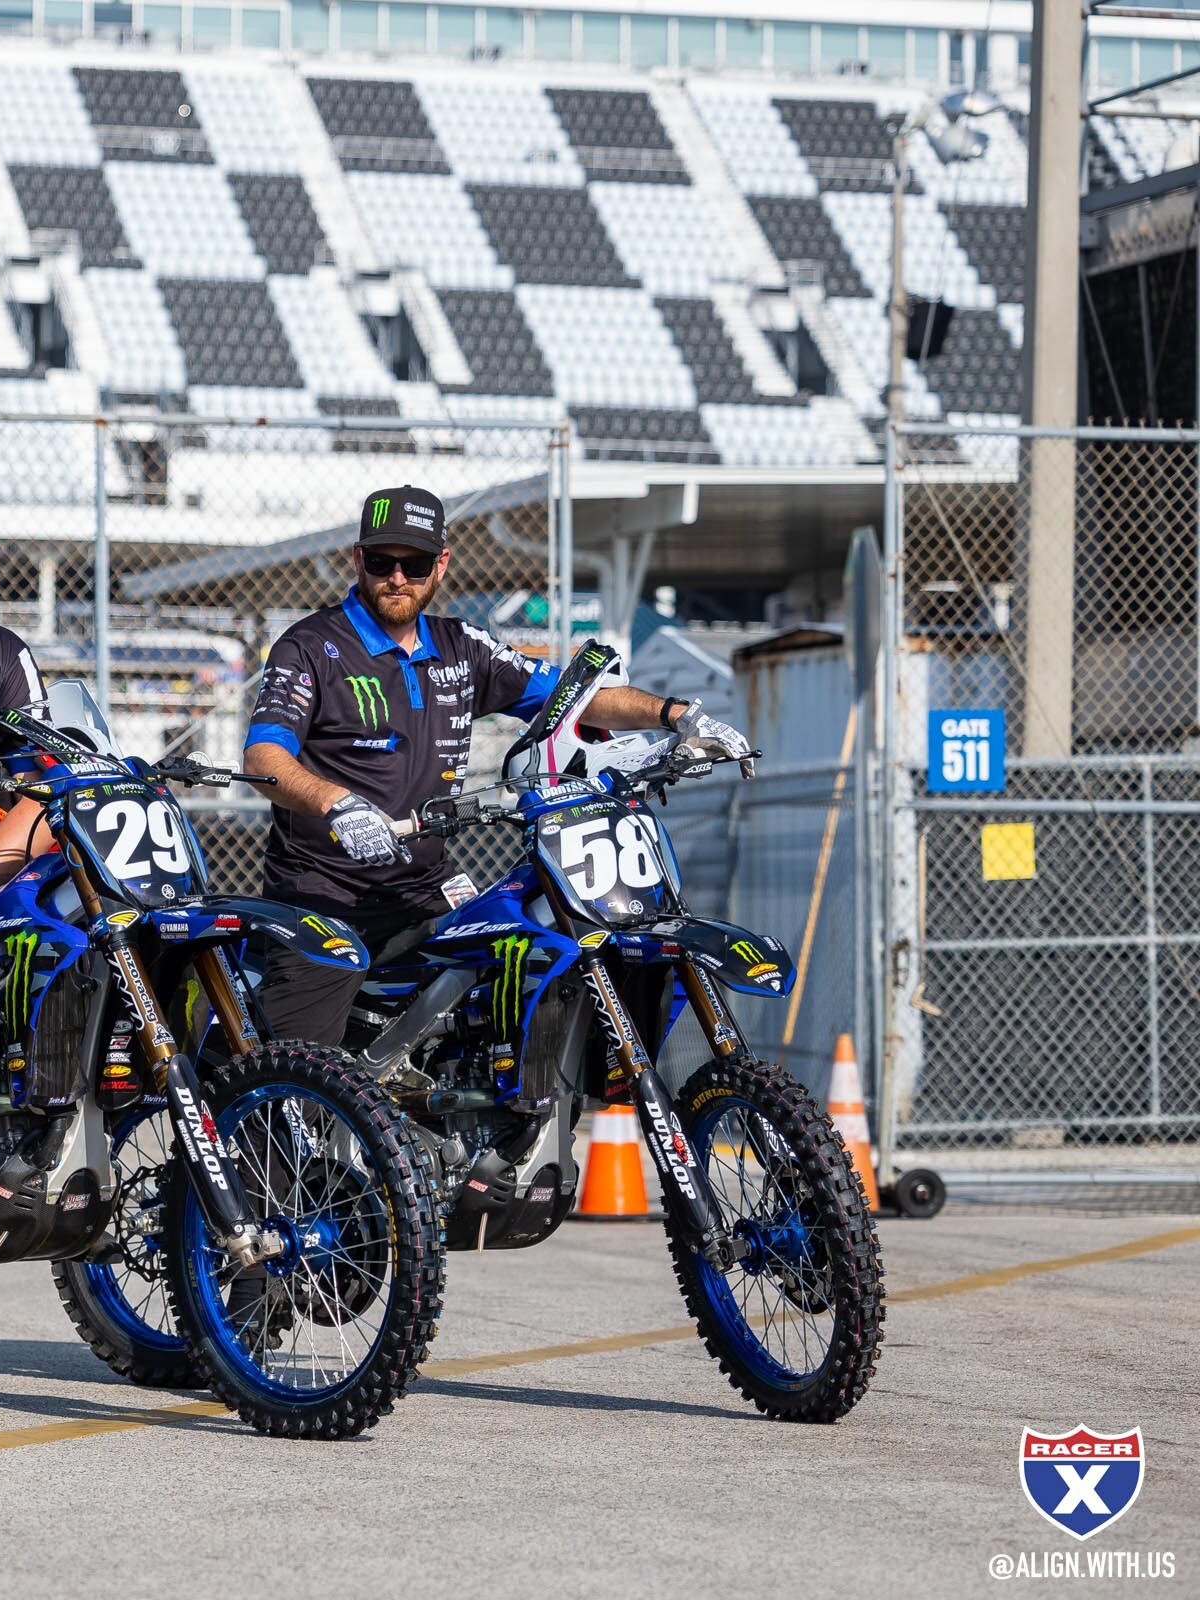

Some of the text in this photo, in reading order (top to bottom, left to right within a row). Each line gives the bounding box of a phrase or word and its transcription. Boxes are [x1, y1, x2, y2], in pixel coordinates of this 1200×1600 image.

[413, 503, 436, 517] YAMAHA
[546, 681, 582, 730] MONSTER
[941, 719, 991, 738] GATE
[683, 762, 712, 774] ARC
[942, 740, 990, 782] 511
[203, 774, 231, 782] ARC
[582, 801, 617, 812] MONSTER
[96, 800, 191, 880] 29
[560, 814, 663, 900] 58
[166, 923, 189, 933] YAMAHA
[436, 921, 523, 939] YZ250F
[627, 949, 643, 957] YAMAHA
[754, 971, 783, 984] YAMAHA
[693, 1087, 734, 1108] DUNLOP
[175, 1086, 229, 1191] DUNLOP
[177, 1119, 199, 1162] BRAKING
[645, 1100, 697, 1200] DUNLOP
[648, 1132, 670, 1174] BRAKING
